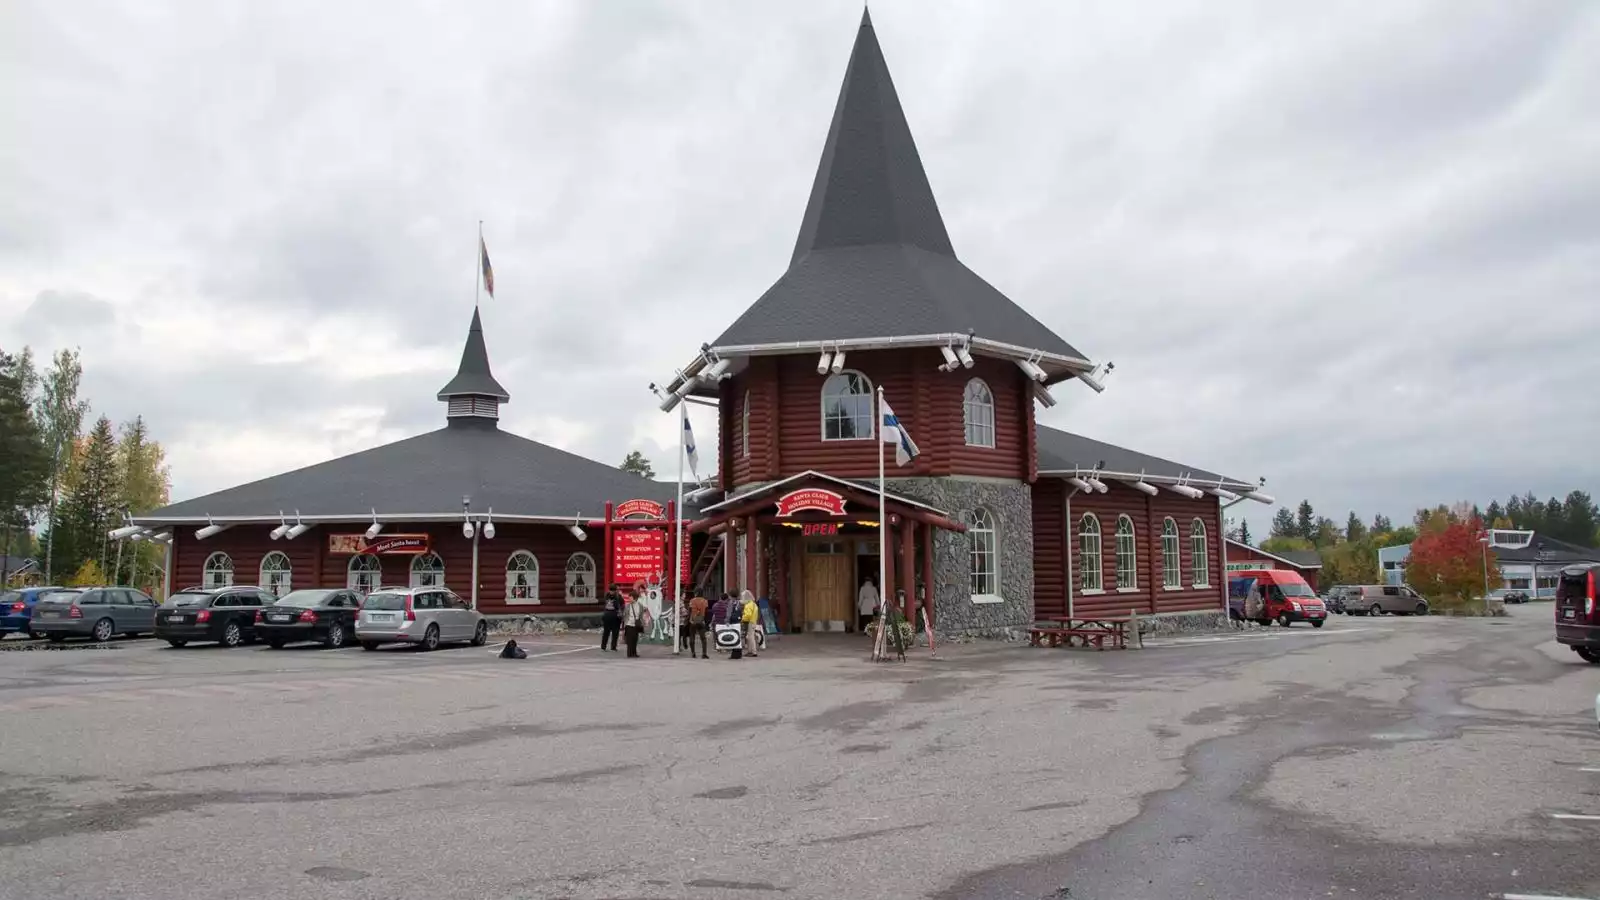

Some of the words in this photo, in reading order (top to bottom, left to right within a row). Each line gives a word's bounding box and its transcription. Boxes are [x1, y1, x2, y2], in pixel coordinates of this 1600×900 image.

[793, 493, 811, 501] SANTA
[811, 492, 829, 500] CLAUS
[788, 500, 811, 509] HOLIDAY
[812, 500, 834, 508] VILLAGE
[804, 523, 837, 536] OPEN
[376, 543, 390, 552] Meet
